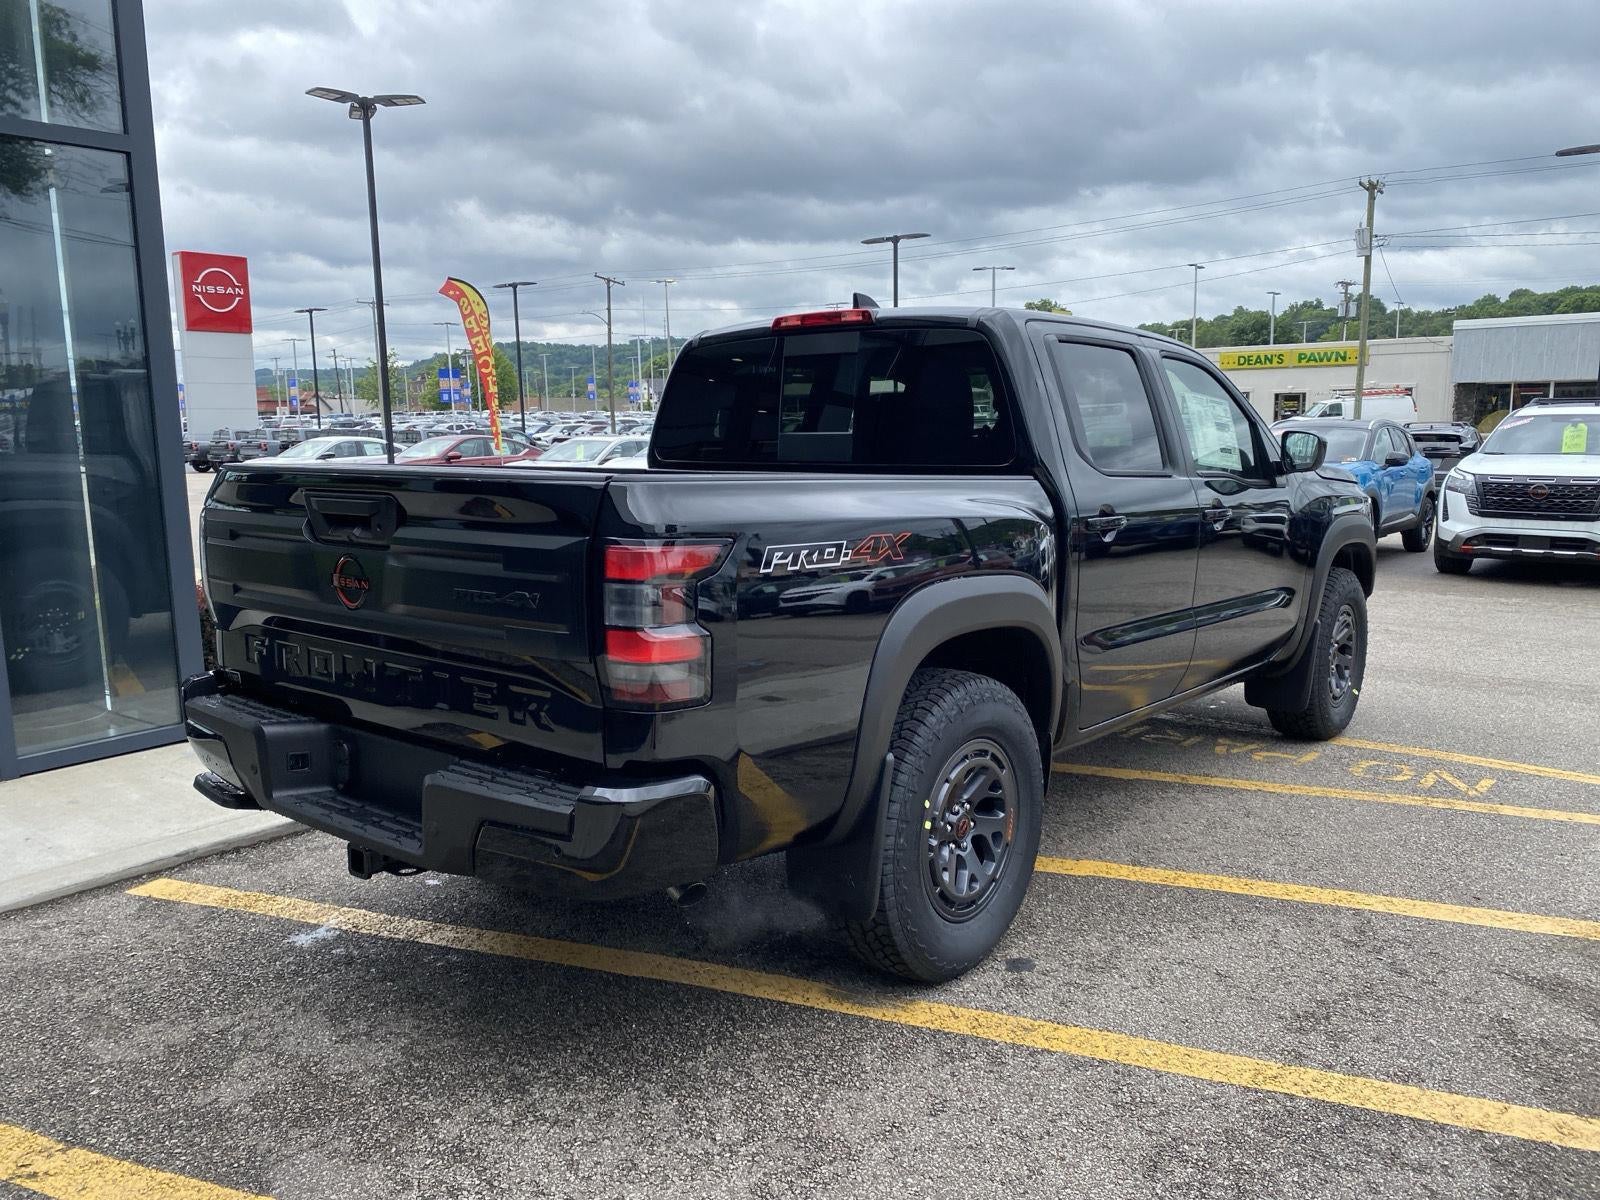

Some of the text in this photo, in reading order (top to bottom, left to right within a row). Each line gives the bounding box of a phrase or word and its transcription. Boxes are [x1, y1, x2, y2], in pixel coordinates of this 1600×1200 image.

[192, 284, 244, 295] NISSAN
[1237, 351, 1348, 366] DEAN'S PAWN
[760, 532, 912, 573] PRO-4X
[246, 634, 555, 732] FRONTIER
[1348, 759, 1498, 797] NO
